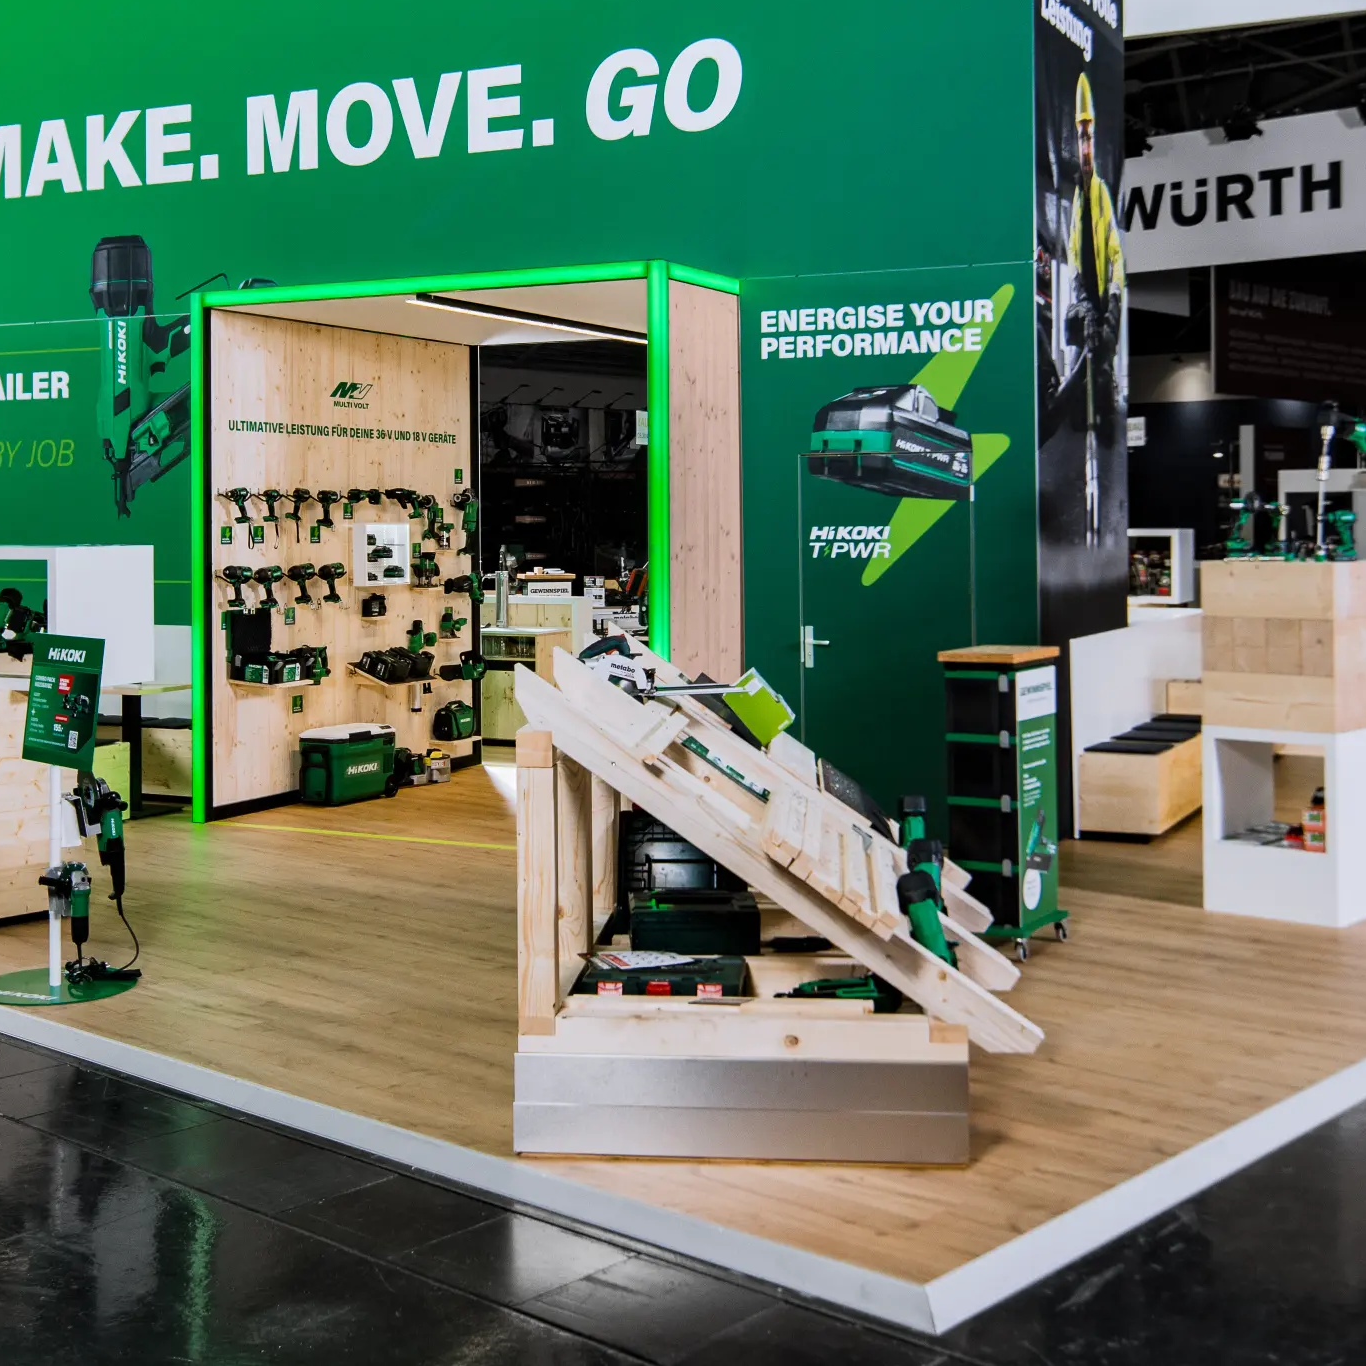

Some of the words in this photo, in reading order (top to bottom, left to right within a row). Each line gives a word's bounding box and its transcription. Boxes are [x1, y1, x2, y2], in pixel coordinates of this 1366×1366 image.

[246, 64, 555, 176] MOVE.
[586, 38, 743, 140] GO
[761, 304, 904, 332] ENERGISE
[910, 299, 994, 324] YOUR
[117, 321, 127, 384] HiKOKI
[761, 328, 982, 360] PERFORMANCE
[334, 400, 353, 408] MULTI
[228, 419, 283, 433] ULTIMATIVE
[285, 423, 329, 437] LEISTUNG
[332, 424, 348, 438] FÜR
[350, 427, 374, 439] DEINE
[376, 429, 385, 439] 36
[394, 430, 411, 441] UND
[412, 431, 420, 441] 18
[428, 431, 456, 444] GERÄTE
[26, 439, 75, 467] JOB
[809, 526, 890, 540] HiKOKI
[48, 647, 86, 663] HiKOKI
[610, 662, 636, 674] metabo
[347, 762, 378, 775] HiKOKI
